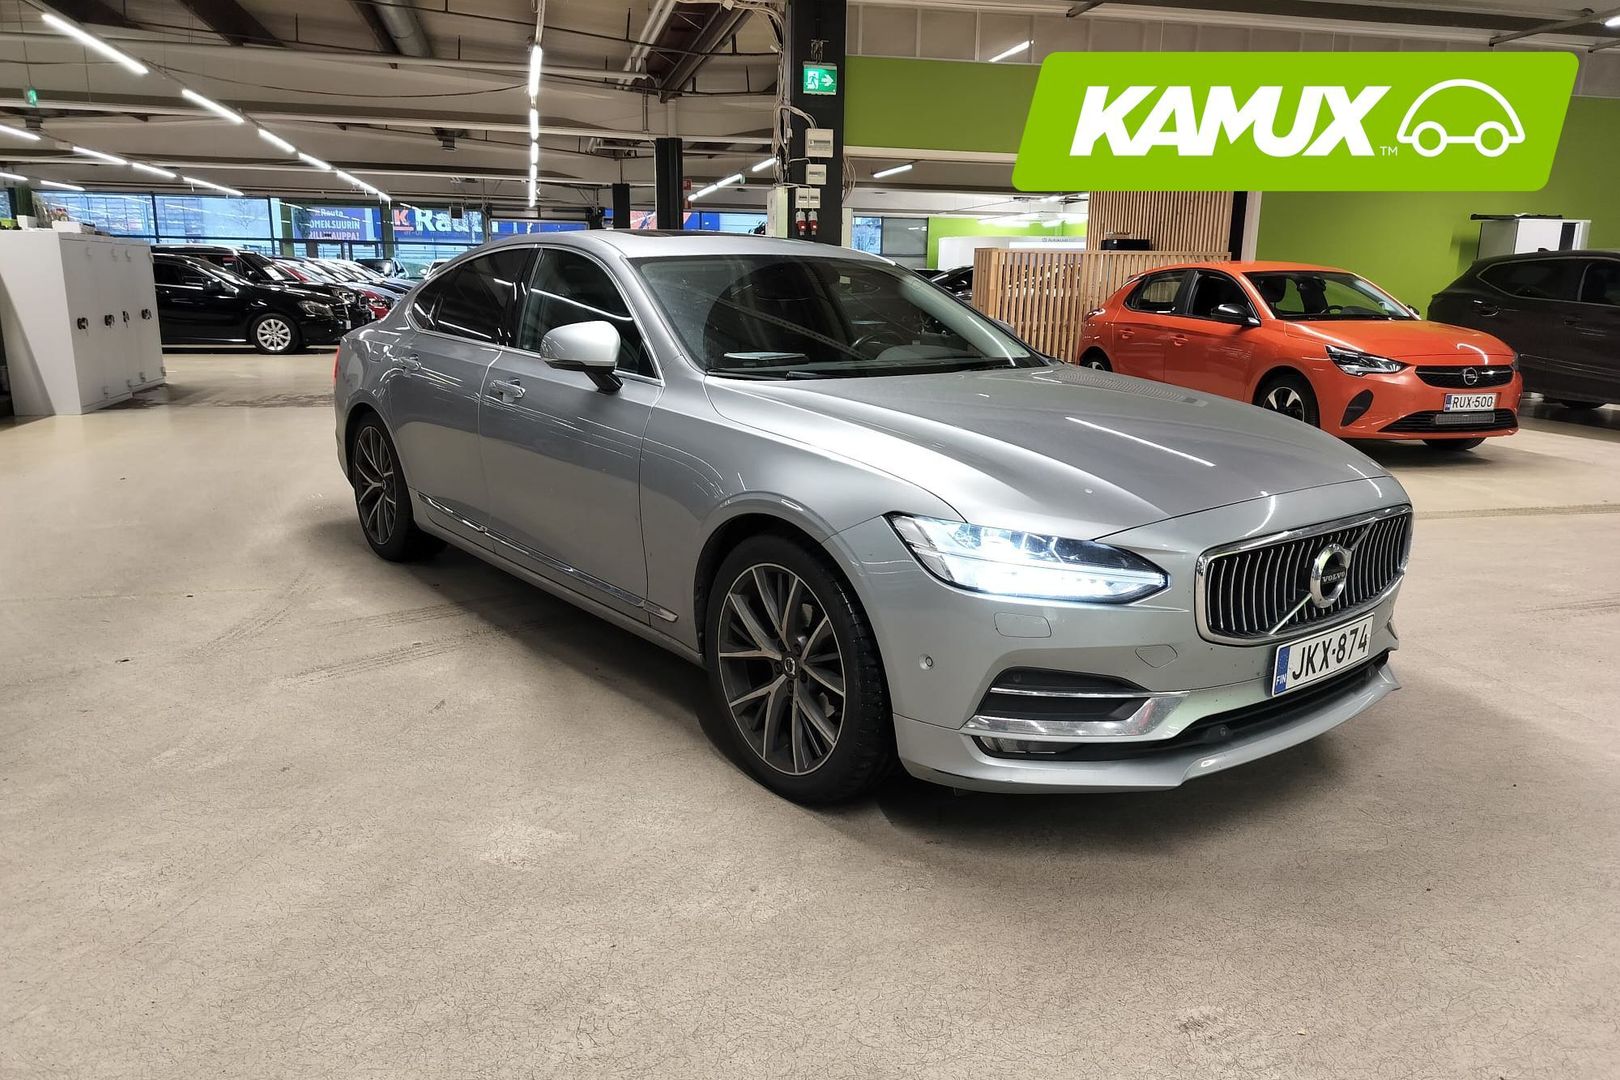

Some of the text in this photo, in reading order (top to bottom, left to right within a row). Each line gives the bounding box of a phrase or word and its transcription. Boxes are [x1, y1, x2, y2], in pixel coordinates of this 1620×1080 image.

[393, 209, 410, 226] K
[1452, 396, 1494, 409] RUX-500
[1322, 571, 1346, 583] VOLVO
[1292, 623, 1368, 681] JKX-874
[1275, 673, 1288, 686] FIN
